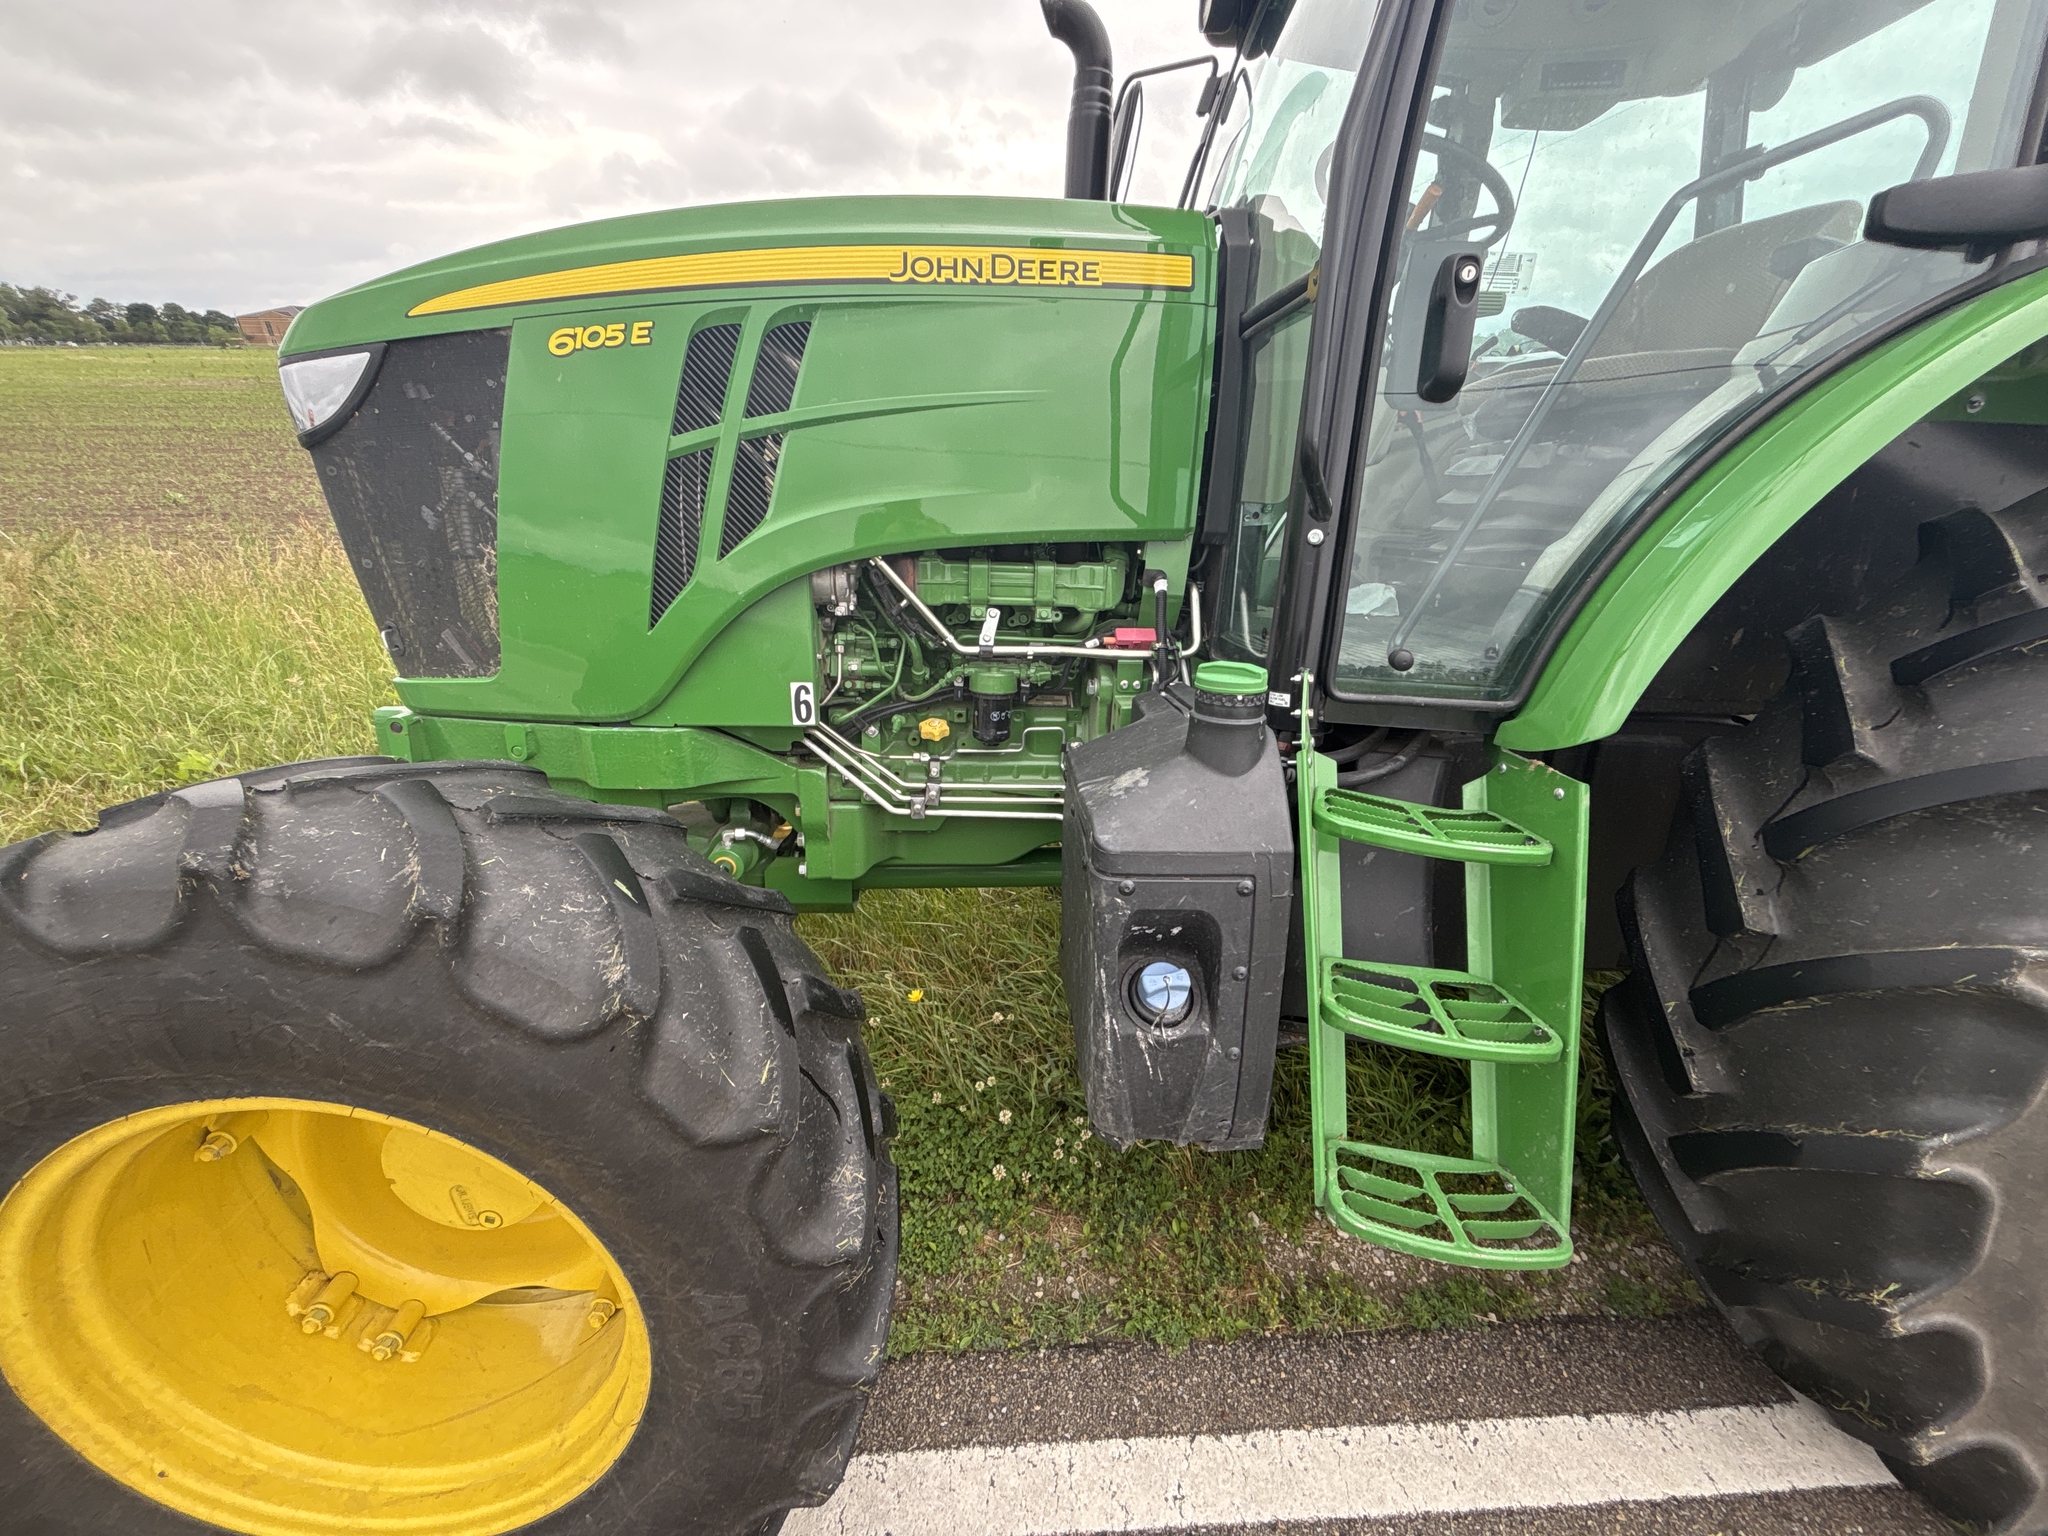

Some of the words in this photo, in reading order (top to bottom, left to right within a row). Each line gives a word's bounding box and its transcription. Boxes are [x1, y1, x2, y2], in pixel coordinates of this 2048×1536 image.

[890, 251, 983, 281] JOHN
[991, 253, 1101, 284] DEERE
[548, 323, 626, 356] 6105
[631, 321, 654, 345] E
[794, 684, 812, 723] 6
